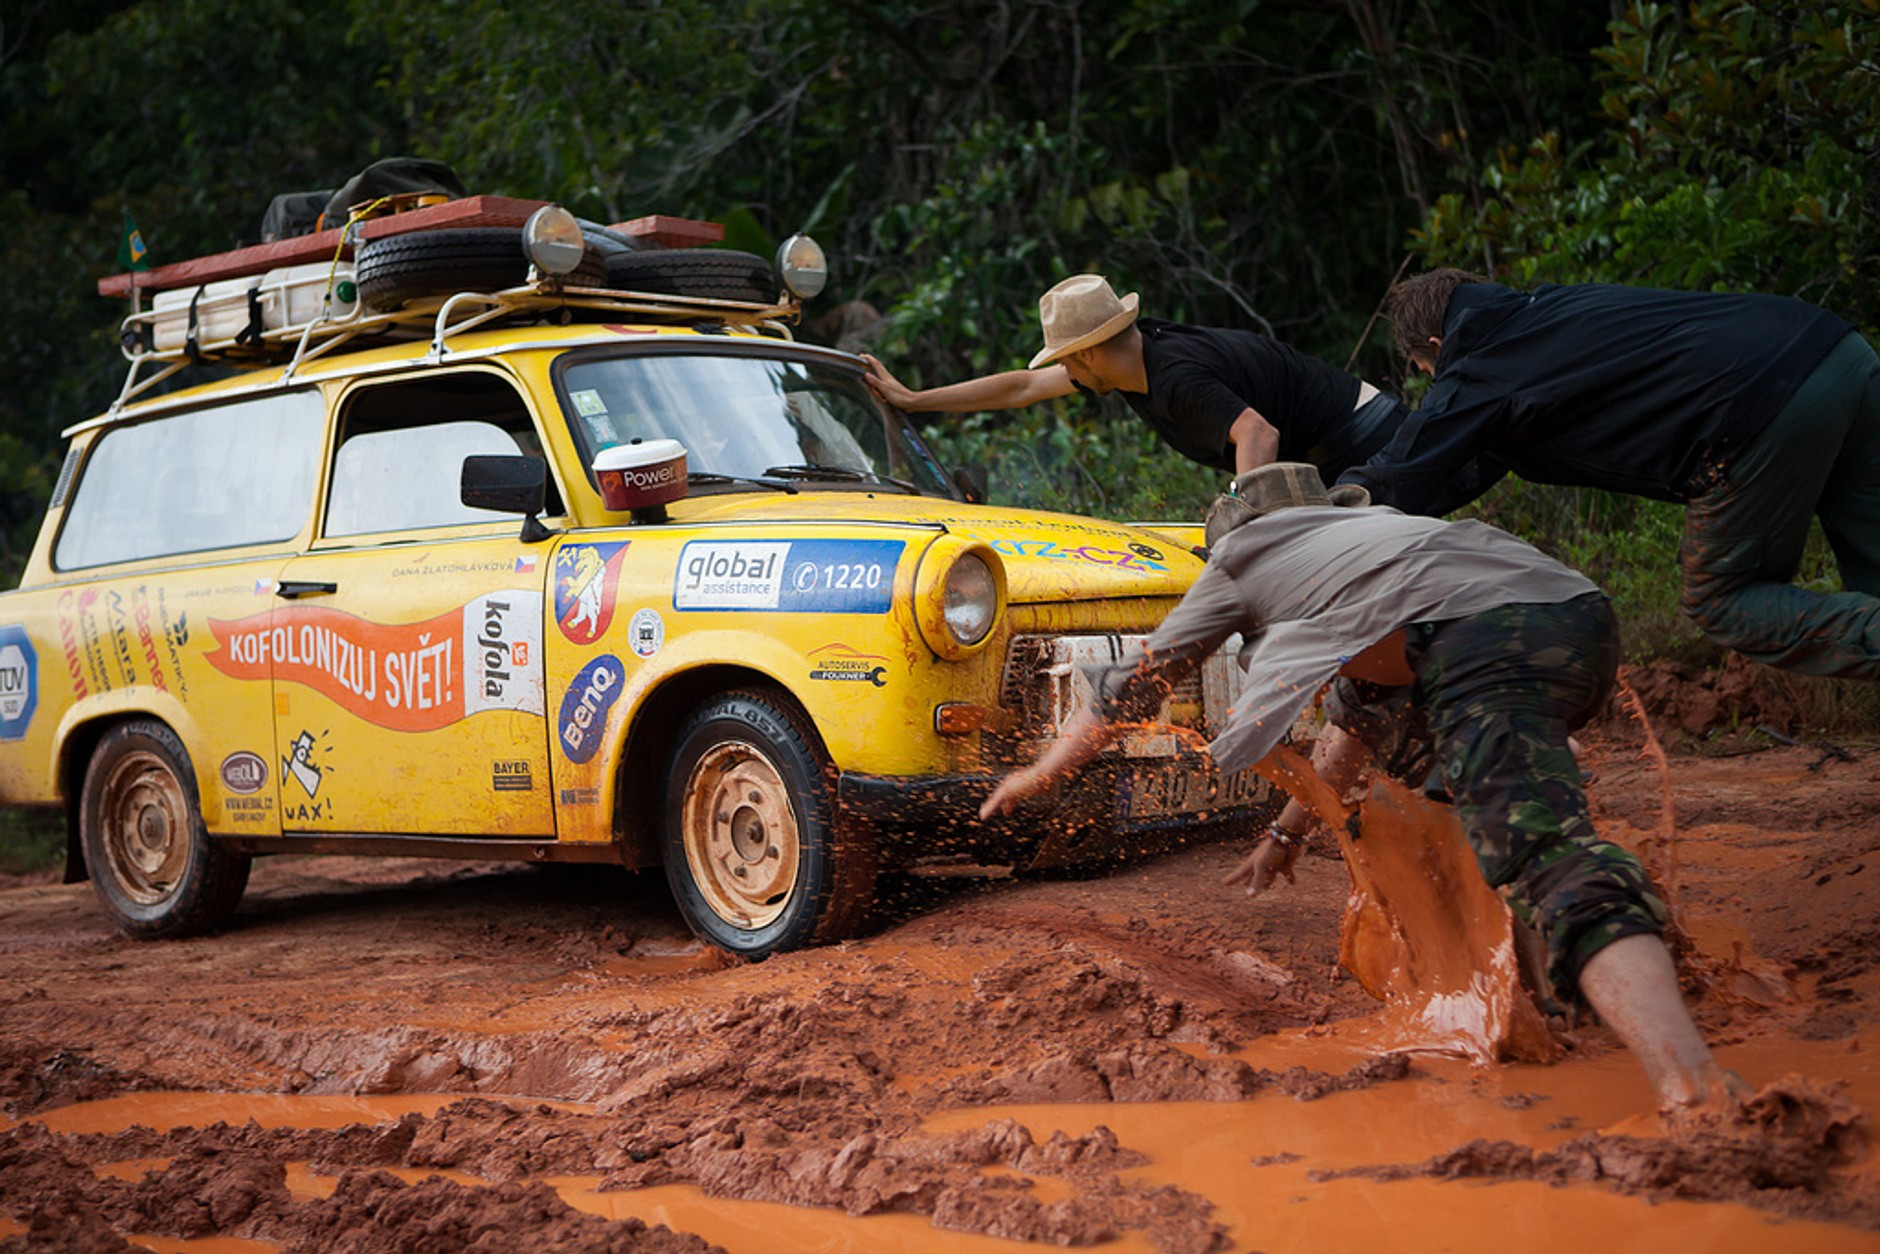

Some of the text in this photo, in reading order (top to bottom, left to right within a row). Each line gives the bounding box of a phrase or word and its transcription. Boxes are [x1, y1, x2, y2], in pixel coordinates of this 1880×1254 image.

[392, 568, 420, 577] DANA
[687, 551, 777, 590] global
[703, 580, 770, 595] assistance
[823, 563, 882, 589] 1220
[57, 590, 88, 701] Canon
[134, 601, 169, 693] Banner
[478, 600, 510, 698] kofola
[230, 624, 376, 702] KOFOLONIZUJ
[385, 632, 453, 710] SVĚT!
[818, 661, 870, 670] AUTOSERVIS
[563, 666, 617, 751] BenQ
[493, 761, 530, 774] BAYER
